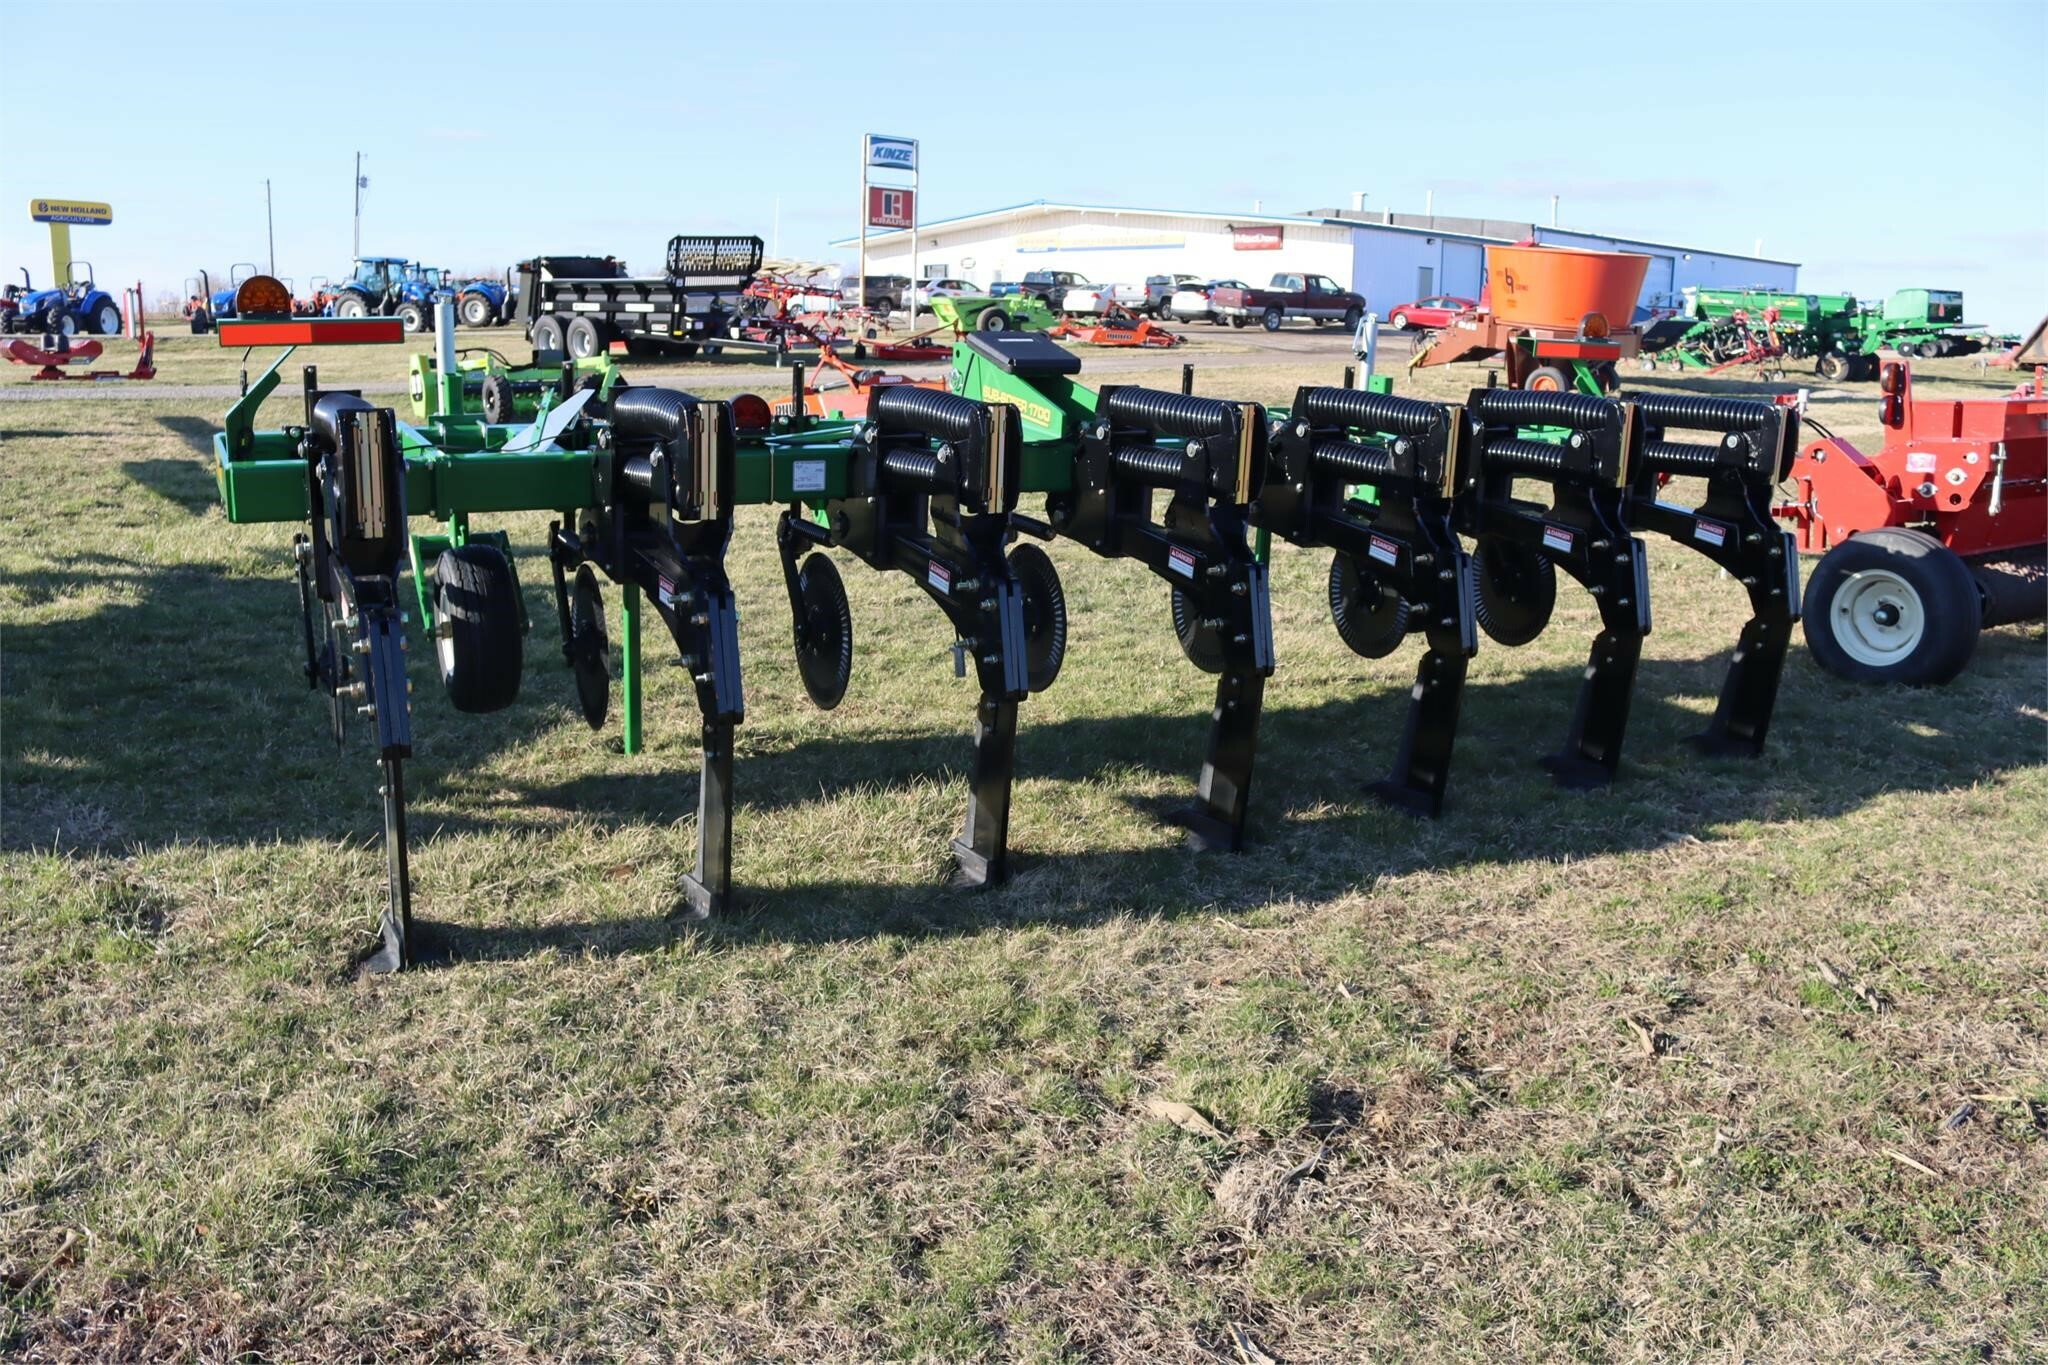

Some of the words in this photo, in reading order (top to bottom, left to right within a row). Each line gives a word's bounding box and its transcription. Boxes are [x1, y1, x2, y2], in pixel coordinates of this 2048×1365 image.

[873, 146, 913, 162] KINZE
[50, 205, 69, 213] NEW
[71, 206, 107, 215] HOLLAND
[50, 215, 95, 223] AGRICULTURE
[871, 216, 913, 226] KRAUSE
[1028, 402, 1051, 422] 1700
